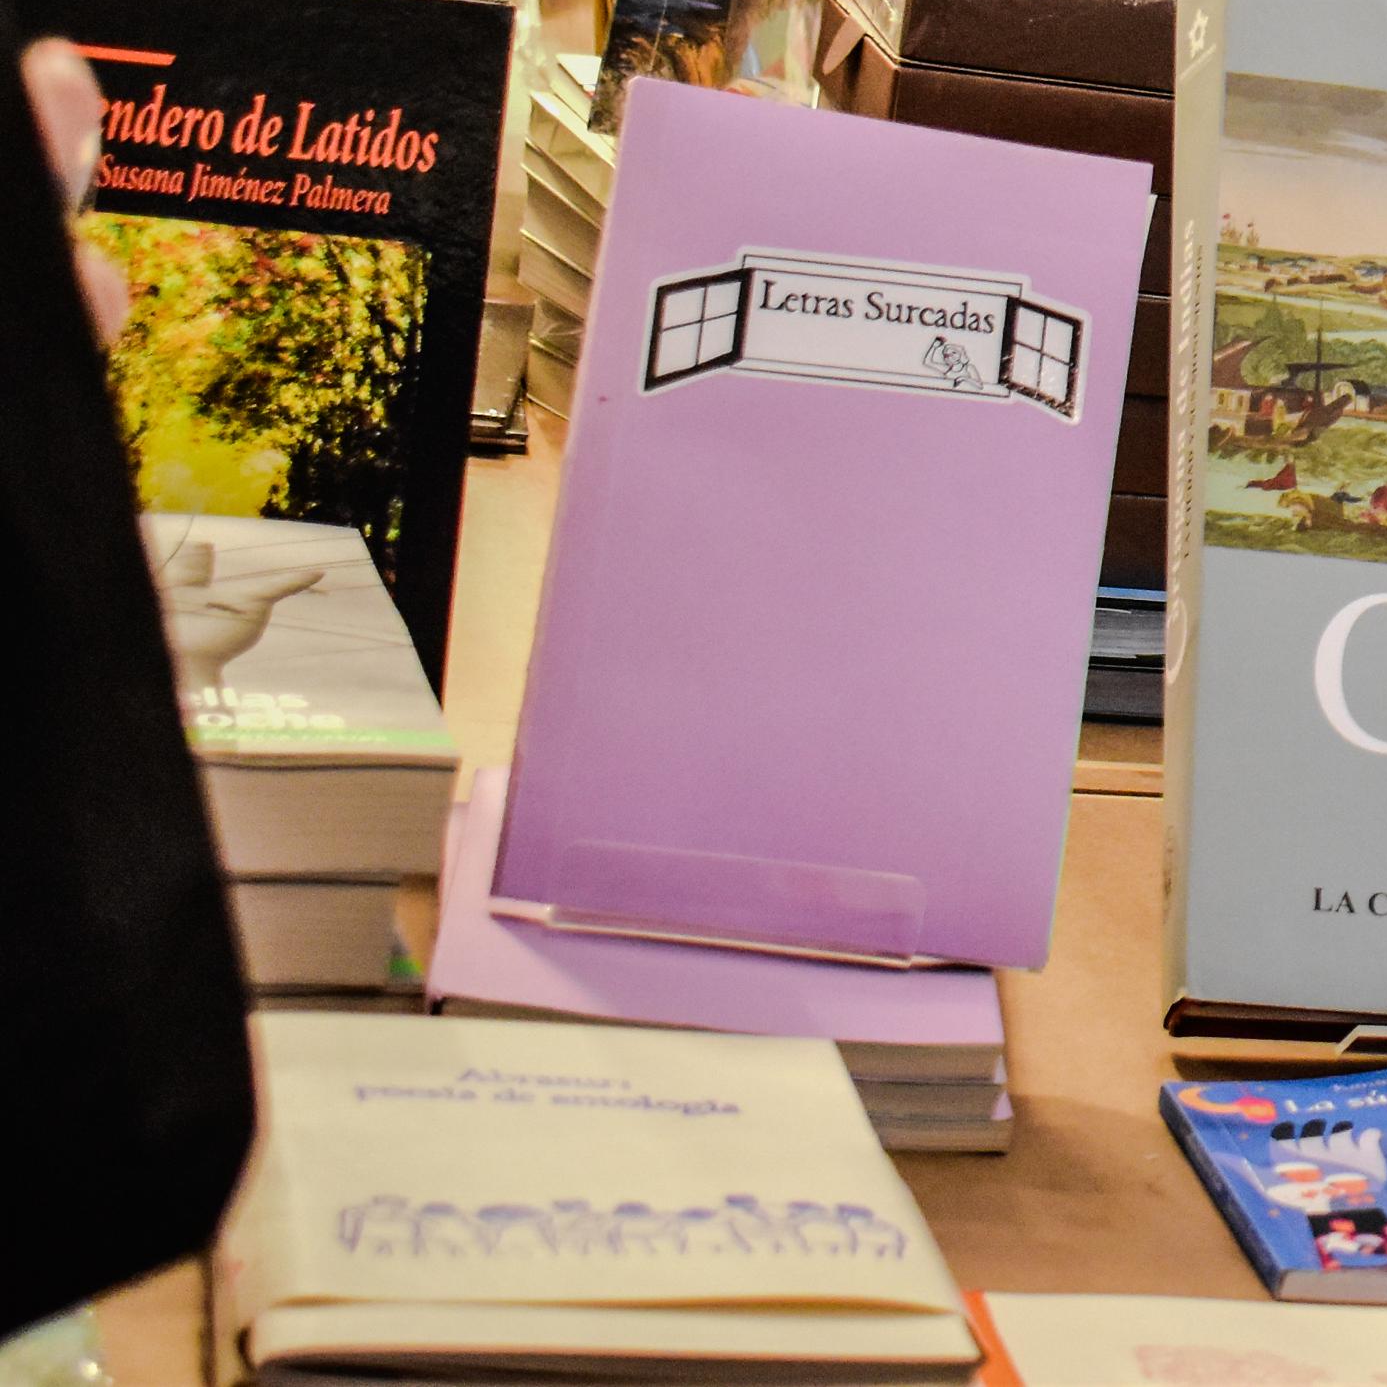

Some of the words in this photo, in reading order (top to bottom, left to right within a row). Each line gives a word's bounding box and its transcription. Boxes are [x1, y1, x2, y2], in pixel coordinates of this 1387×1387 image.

[231, 93, 285, 157] de
[287, 100, 440, 173] Latidos
[187, 162, 287, 204] Jiménez
[289, 172, 393, 216] Palmera
[759, 279, 853, 320] Letras
[864, 291, 996, 335] Surcadas
[1178, 219, 1194, 356] Indias
[1312, 886, 1355, 916] LA
[1283, 1097, 1337, 1115] La
